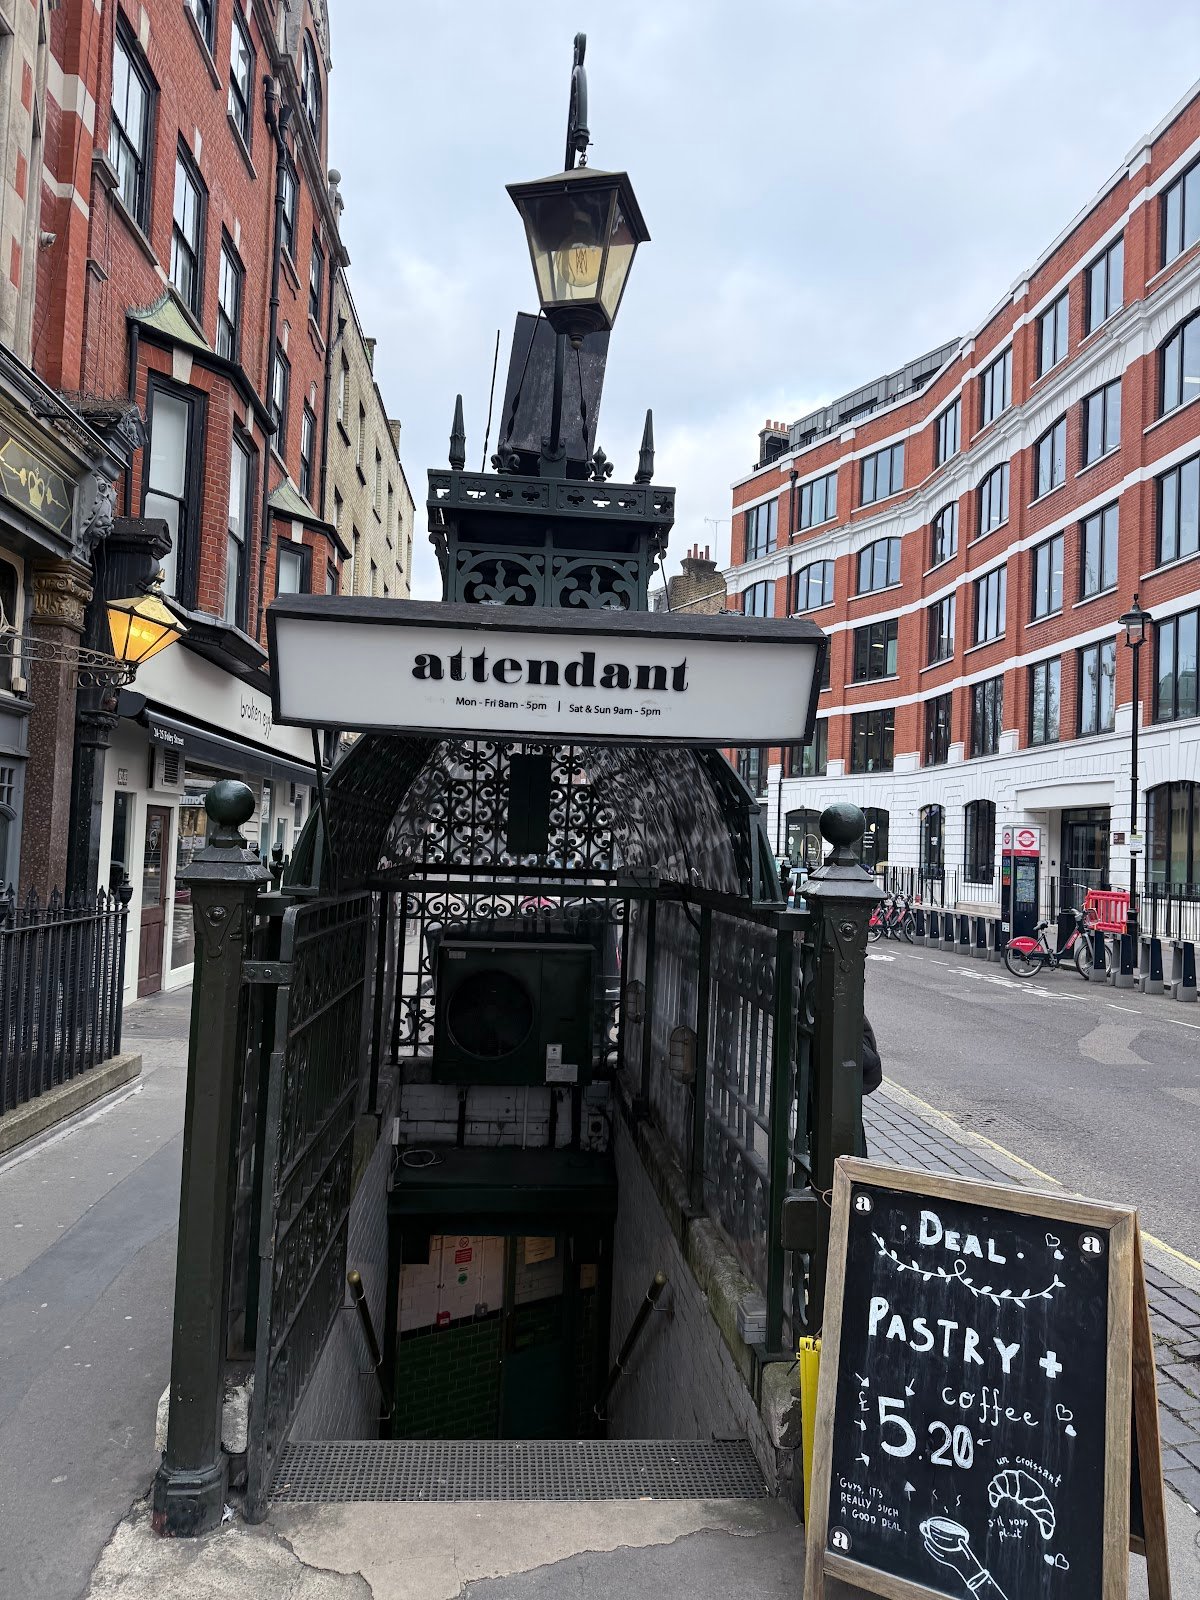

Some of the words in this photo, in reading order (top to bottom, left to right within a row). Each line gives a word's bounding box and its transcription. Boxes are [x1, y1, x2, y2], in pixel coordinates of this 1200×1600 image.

[411, 646, 689, 692] attendant
[455, 696, 477, 706] Mon
[484, 698, 496, 708] Fri
[498, 700, 518, 709] 8am
[526, 701, 547, 711] 5pm
[569, 704, 583, 713] Sat
[585, 705, 592, 713] &
[594, 705, 611, 714] Sun
[613, 706, 632, 715] 9am
[640, 707, 661, 717] 5pm
[855, 1196, 871, 1212] a
[919, 1210, 1007, 1265] DEAL
[1082, 1236, 1102, 1254] a
[868, 1296, 1021, 1375] PASTRY
[942, 1386, 1039, 1427] coffee
[878, 1396, 974, 1470] 5.20
[996, 1456, 1009, 1466] un
[1015, 1455, 1062, 1487] croissant
[840, 1491, 872, 1509] REALLY
[877, 1504, 899, 1517] SUCH
[840, 1506, 847, 1515] A
[851, 1509, 876, 1525] GOOD
[1009, 1518, 1029, 1527] vous
[832, 1530, 849, 1550] a
